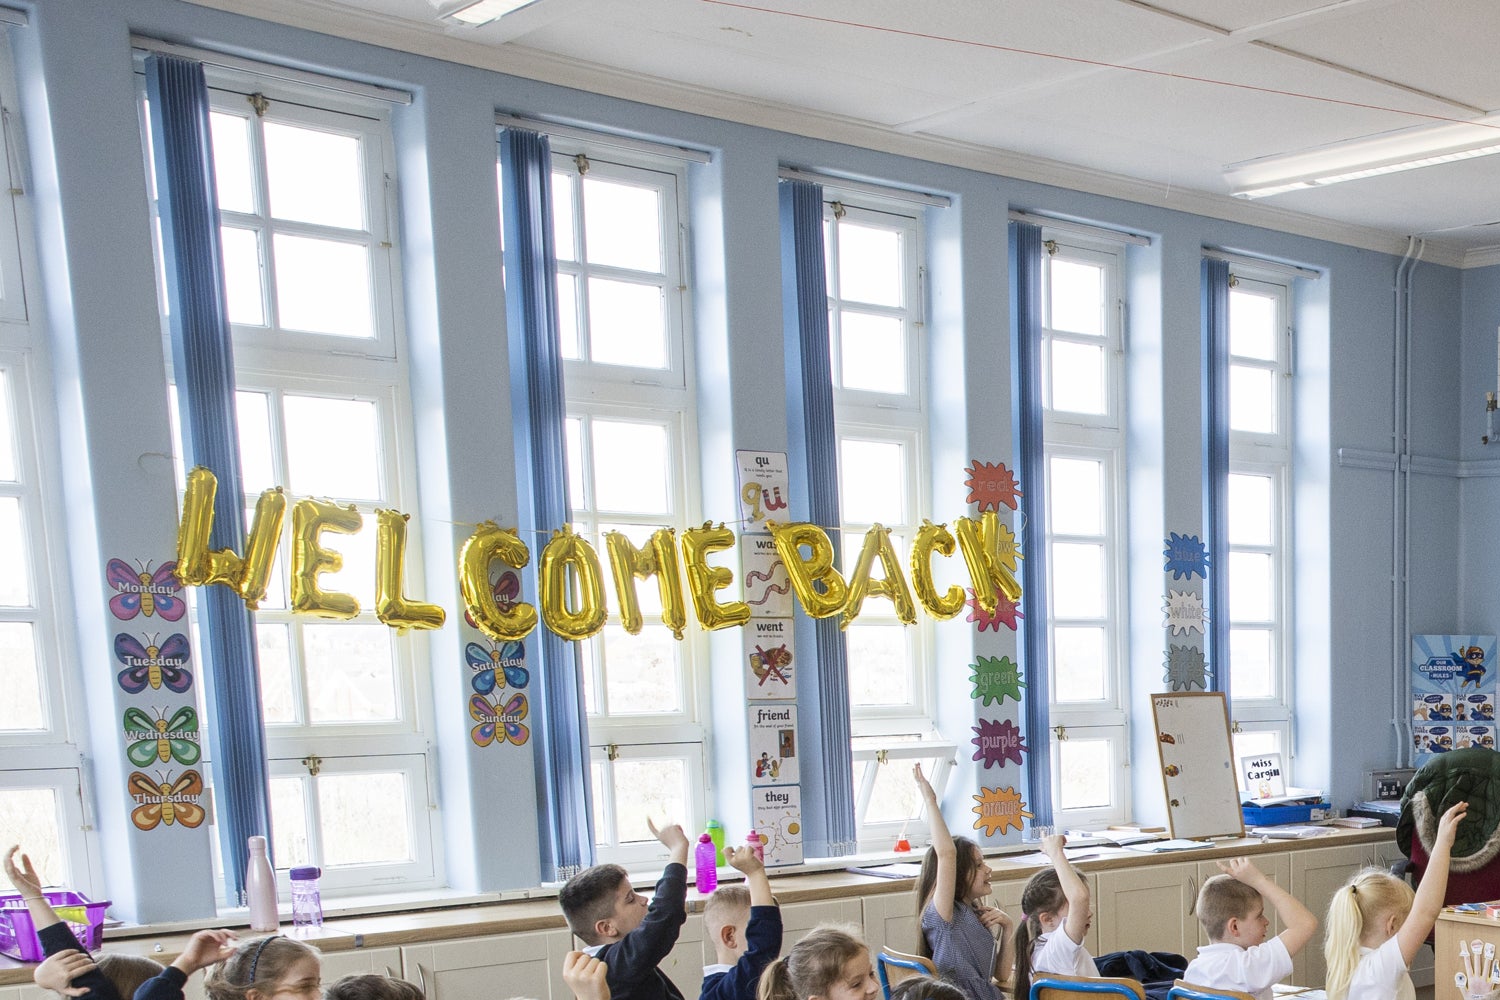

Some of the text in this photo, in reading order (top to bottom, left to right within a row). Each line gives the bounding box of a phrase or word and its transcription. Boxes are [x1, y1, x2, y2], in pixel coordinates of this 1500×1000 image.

[755, 456, 770, 467] qu
[978, 476, 1010, 493] red
[742, 482, 787, 522] qu
[175, 465, 1022, 642] WELCOME BACK
[118, 582, 174, 597] Monday
[1170, 602, 1202, 620] white
[757, 621, 783, 631] went
[124, 656, 182, 669] Tuesday
[472, 656, 523, 672] Saturday
[980, 670, 1015, 692] green
[478, 712, 520, 725] Sunday
[757, 709, 790, 724] friend
[124, 729, 200, 743] Wednesday
[982, 730, 1018, 755] purple
[1252, 759, 1272, 768] Miss
[134, 792, 200, 805] Thursday
[765, 791, 789, 804] they
[983, 801, 1018, 822] orange
